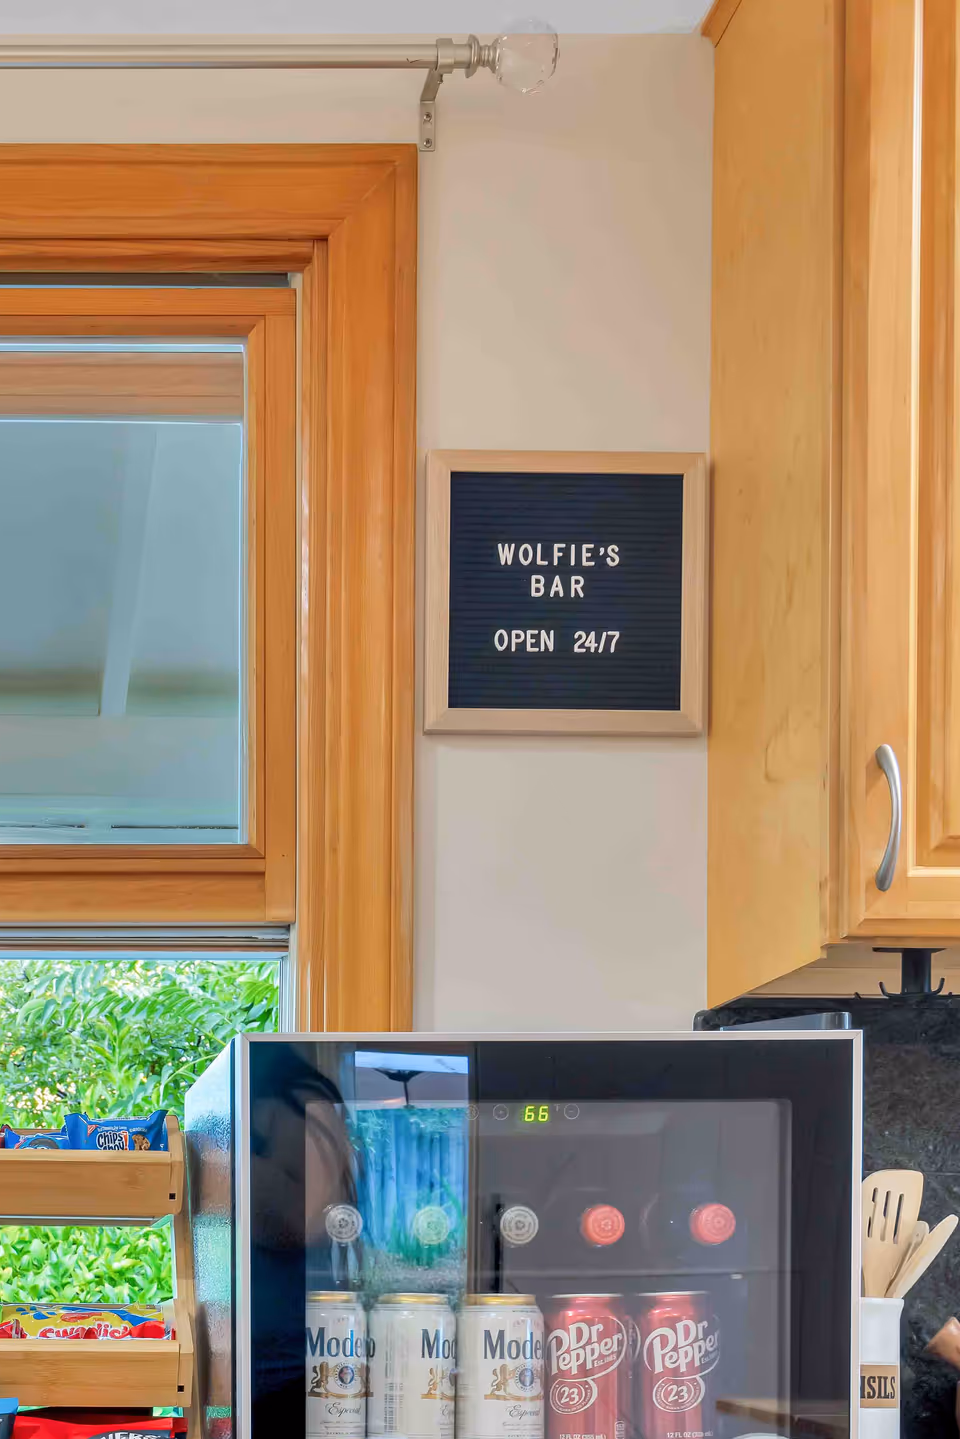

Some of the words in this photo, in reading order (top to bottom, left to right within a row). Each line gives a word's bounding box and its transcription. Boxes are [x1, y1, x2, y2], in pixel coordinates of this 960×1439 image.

[497, 543, 620, 567] WOLFIE'S
[531, 575, 585, 598] BAR
[494, 629, 555, 652] OPEN
[573, 631, 620, 654] 24/7
[524, 1105, 549, 1122] 66
[96, 1131, 124, 1148] Chips
[568, 1321, 604, 1351] Dr
[675, 1319, 709, 1347] Dr
[548, 1328, 624, 1376] Pepper
[648, 1326, 720, 1374] Pepper
[560, 1385, 580, 1405] 23
[667, 1384, 689, 1402] 23
[324, 1401, 362, 1418] Especial
